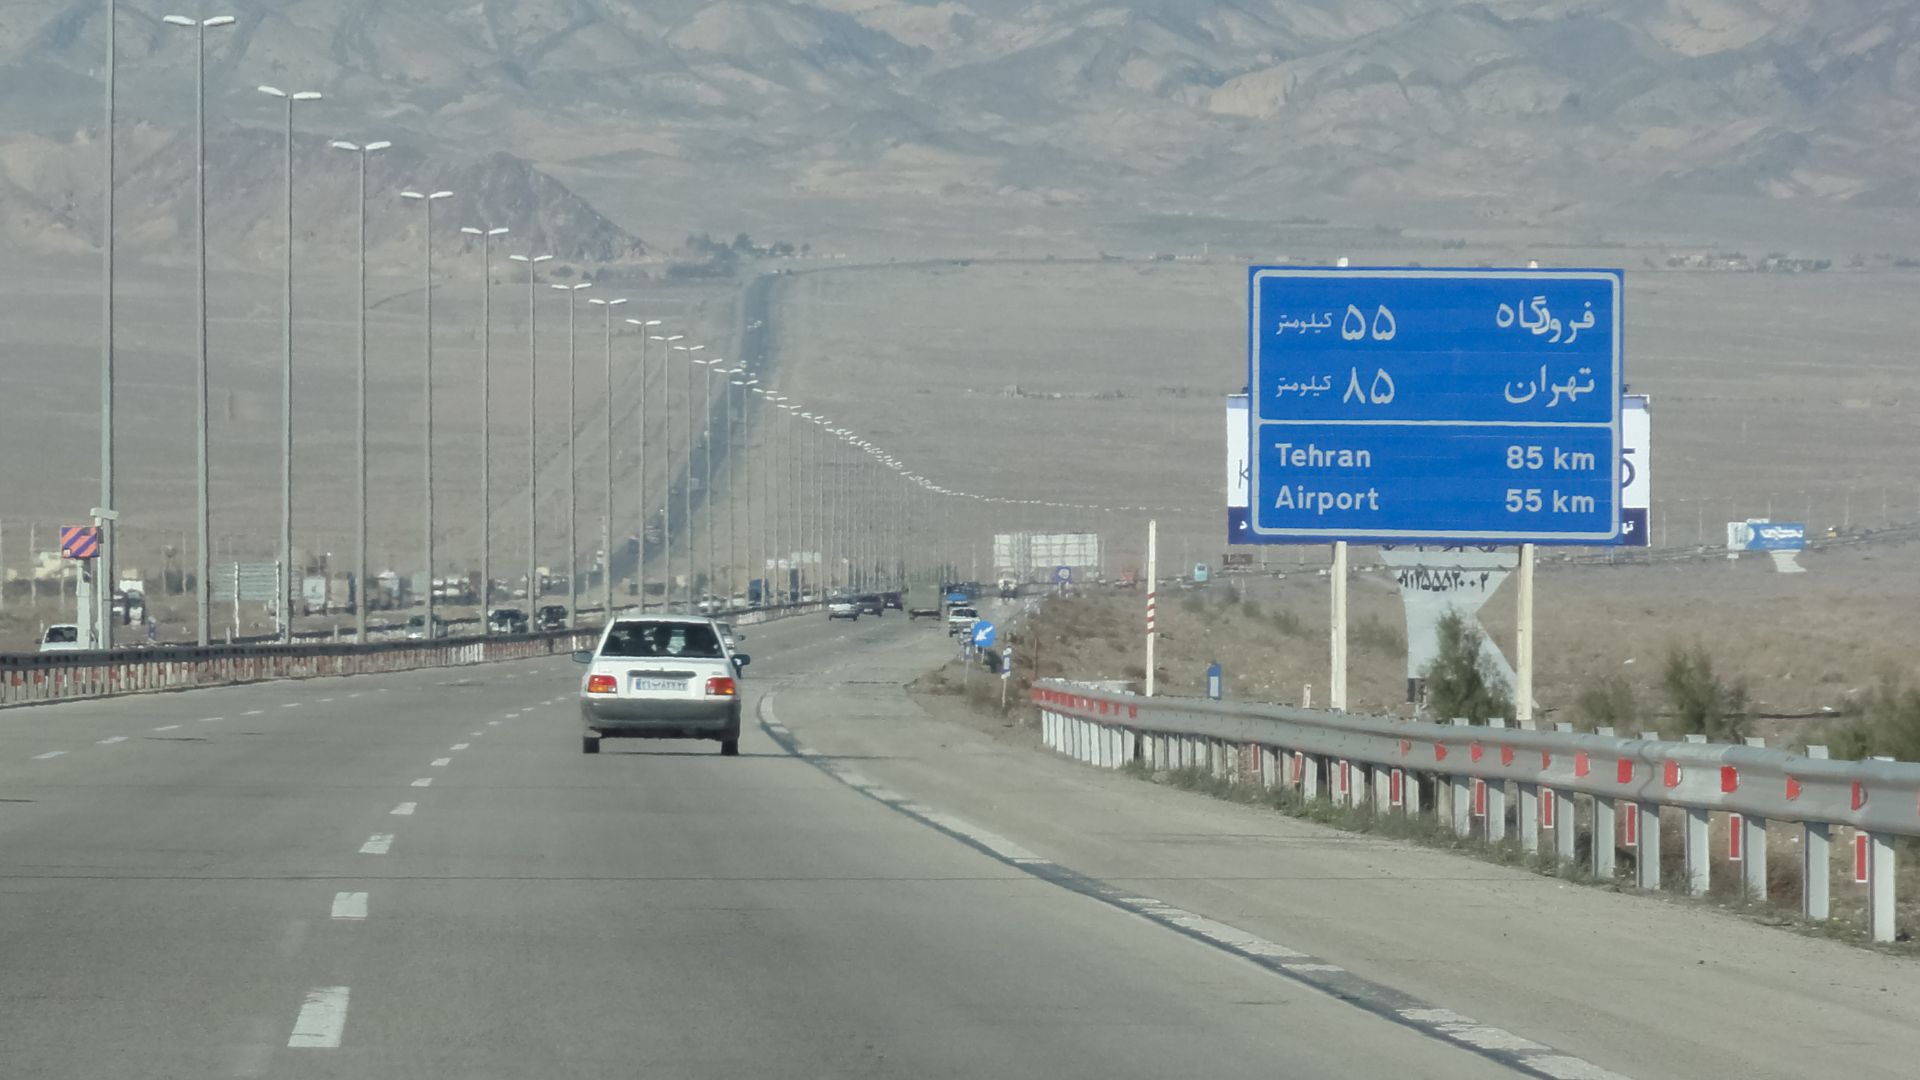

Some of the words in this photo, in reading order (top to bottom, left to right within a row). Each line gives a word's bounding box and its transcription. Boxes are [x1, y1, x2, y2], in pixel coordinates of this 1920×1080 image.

[1276, 312, 1333, 335] کیلومتر
[1341, 304, 1397, 341] ۵۵
[1496, 296, 1596, 343] فرودگاه
[1276, 375, 1332, 398] کیلومتر
[1343, 366, 1396, 405] ۸۵
[1504, 364, 1595, 407] تهران
[1275, 443, 1371, 468] Tehran
[1506, 446, 1544, 469] 85
[1553, 446, 1595, 470] km
[1275, 485, 1379, 515] Airport
[1505, 489, 1543, 512] 55
[1553, 489, 1595, 513] km
